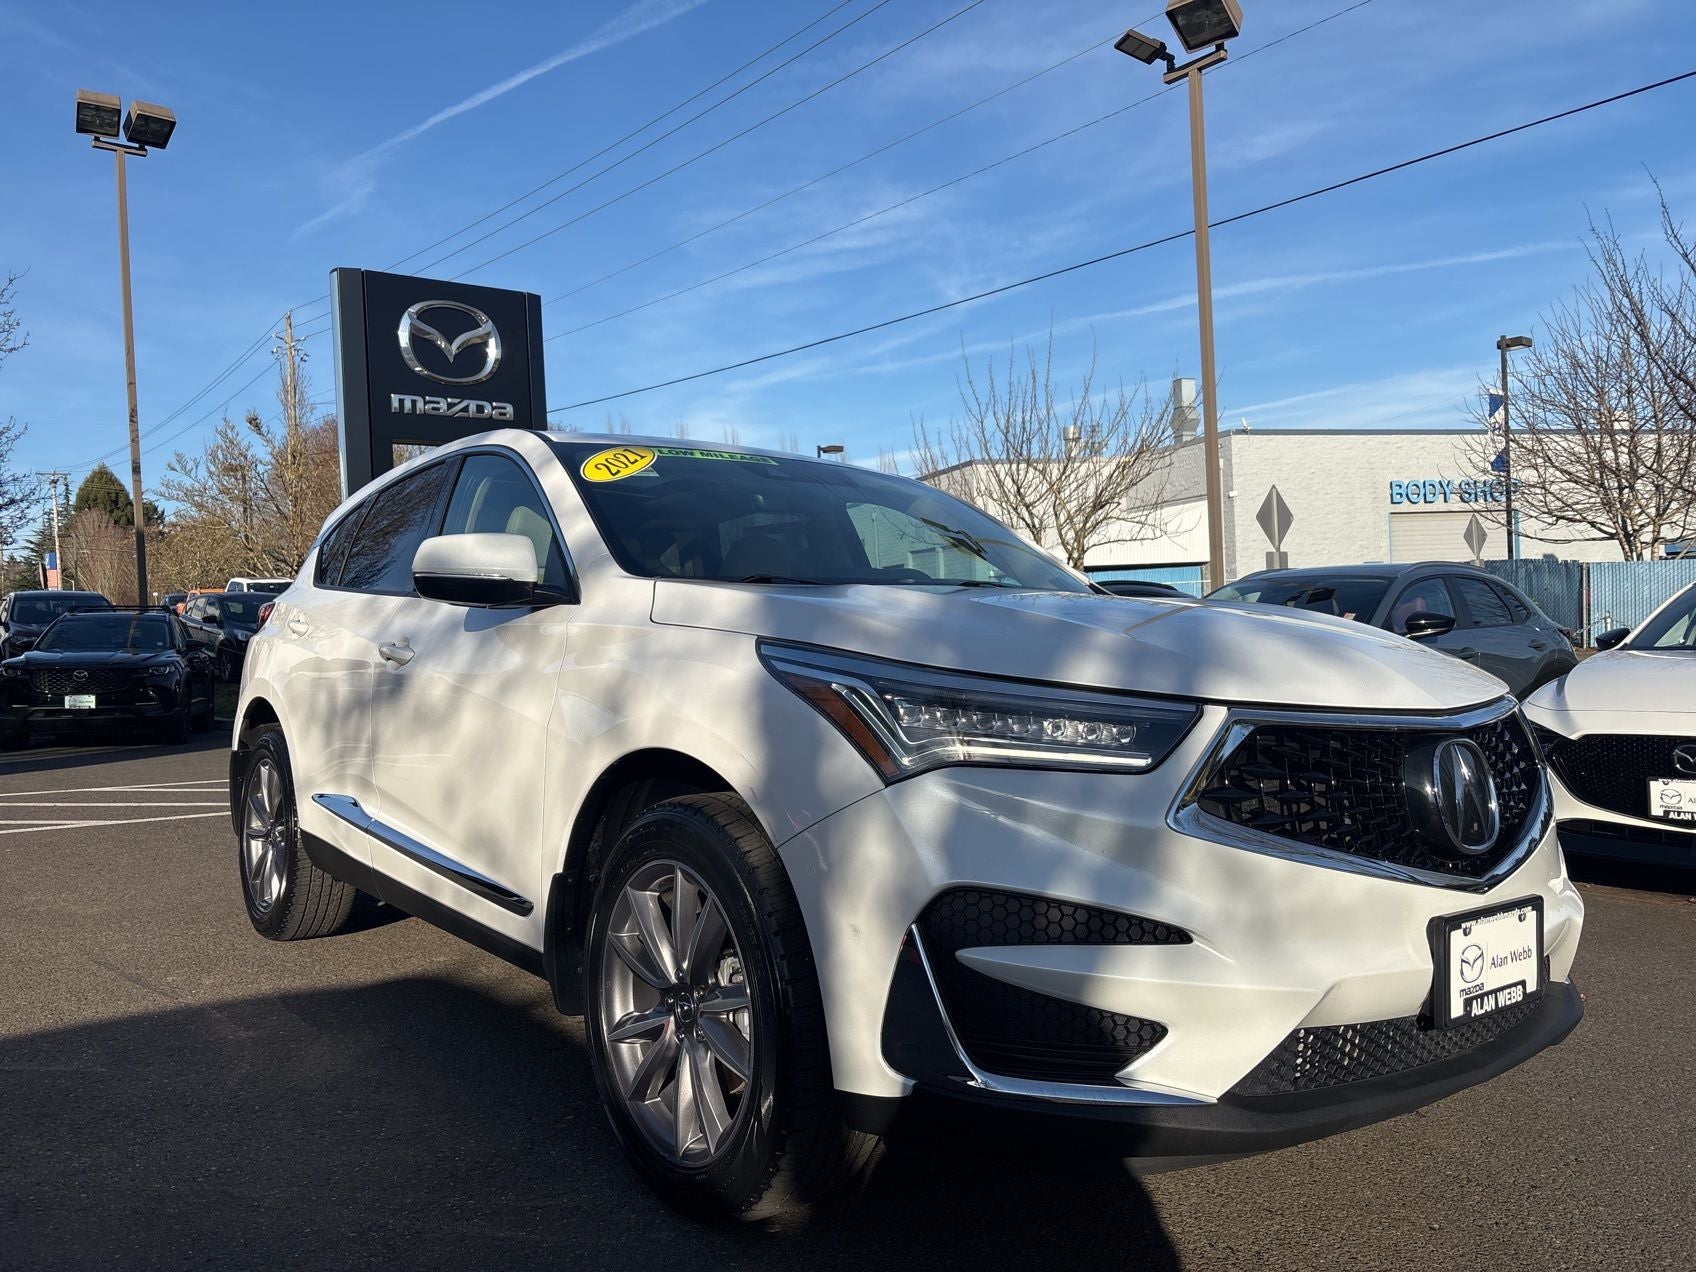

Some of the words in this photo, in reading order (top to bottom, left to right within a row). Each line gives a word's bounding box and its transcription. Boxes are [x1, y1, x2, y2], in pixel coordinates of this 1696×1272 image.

[391, 394, 514, 421] mazda
[594, 448, 648, 477] 2021
[658, 448, 695, 457] LOW
[700, 450, 773, 464] MILEAGE
[1390, 480, 1454, 505] BODY
[1669, 811, 1692, 820] ALAN
[1490, 954, 1508, 970] Alan
[1510, 944, 1533, 964] Webb
[1459, 982, 1485, 998] mazda
[1471, 994, 1495, 1017] ALAN
[1497, 985, 1523, 1007] WEBB
